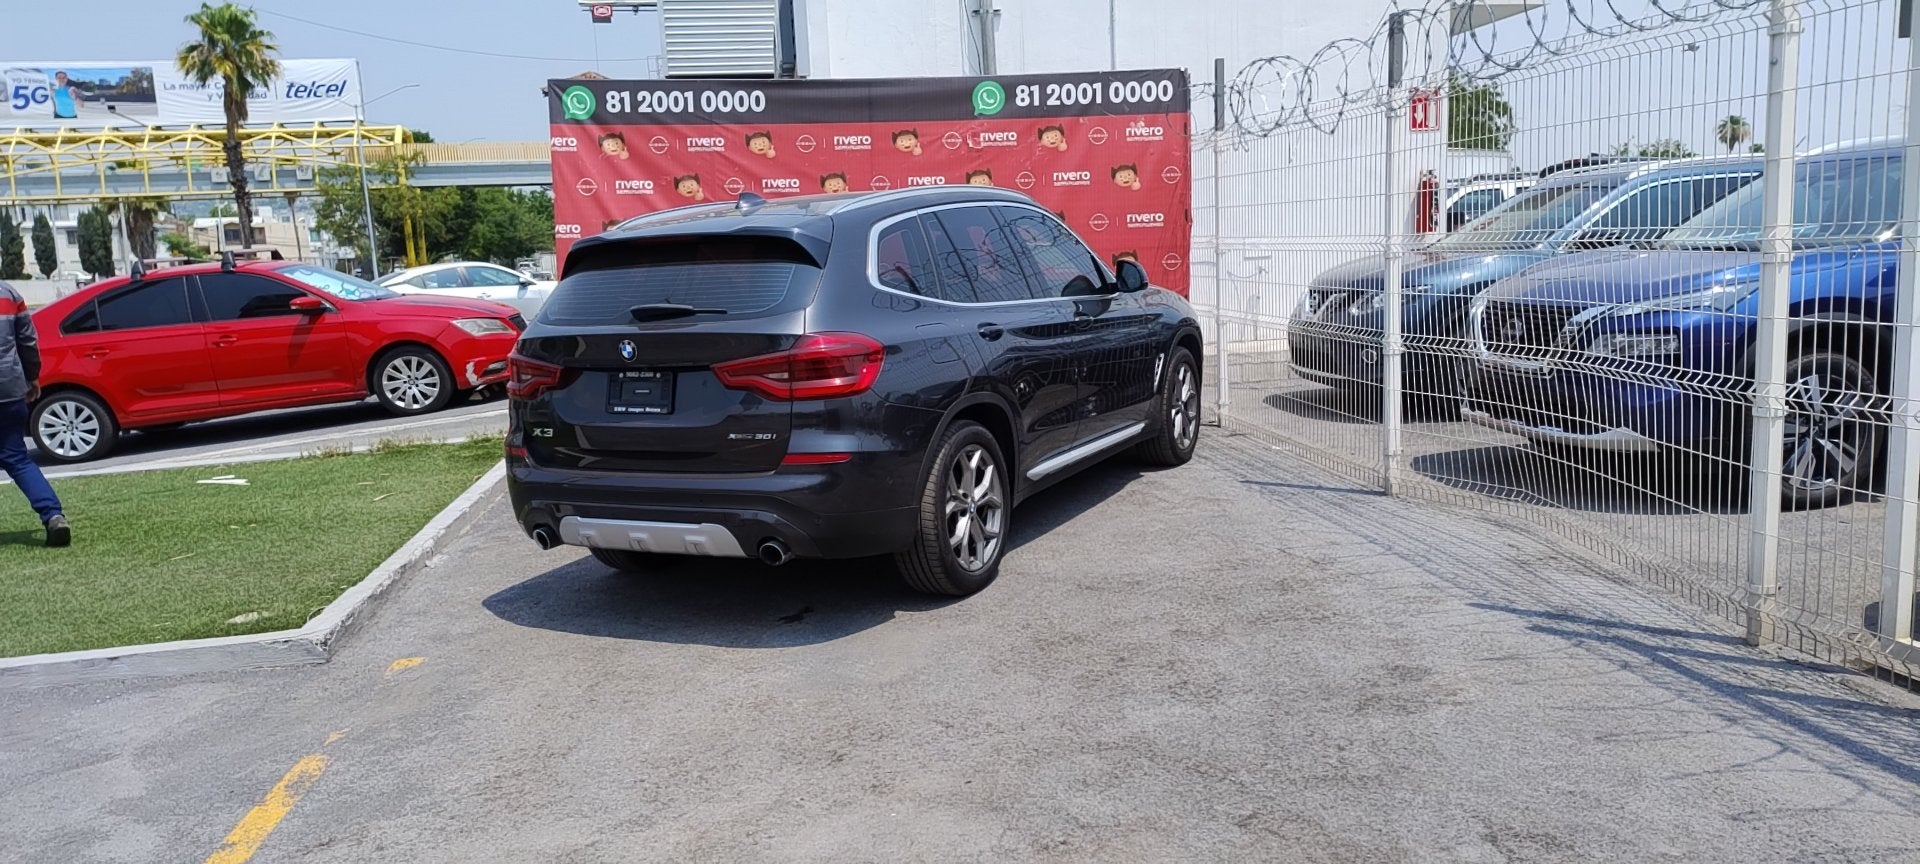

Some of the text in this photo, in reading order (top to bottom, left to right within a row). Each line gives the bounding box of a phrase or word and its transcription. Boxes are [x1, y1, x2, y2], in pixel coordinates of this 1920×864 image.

[163, 82, 176, 91] La
[179, 82, 210, 92] mayr
[285, 80, 347, 99] telcel
[12, 86, 50, 109] 5G
[1015, 80, 1174, 107] 81 2001 0000
[605, 89, 766, 114] 81 2001 0000
[1126, 125, 1164, 136] rivero
[687, 137, 725, 147] rivero
[834, 135, 871, 146] rivero
[979, 131, 1017, 142] rivero
[908, 176, 946, 187] rivero
[1053, 171, 1091, 182] rivero
[615, 179, 653, 190] rivero
[762, 178, 800, 188] rivero
[1126, 212, 1164, 223] rivero
[531, 427, 554, 438] X3
